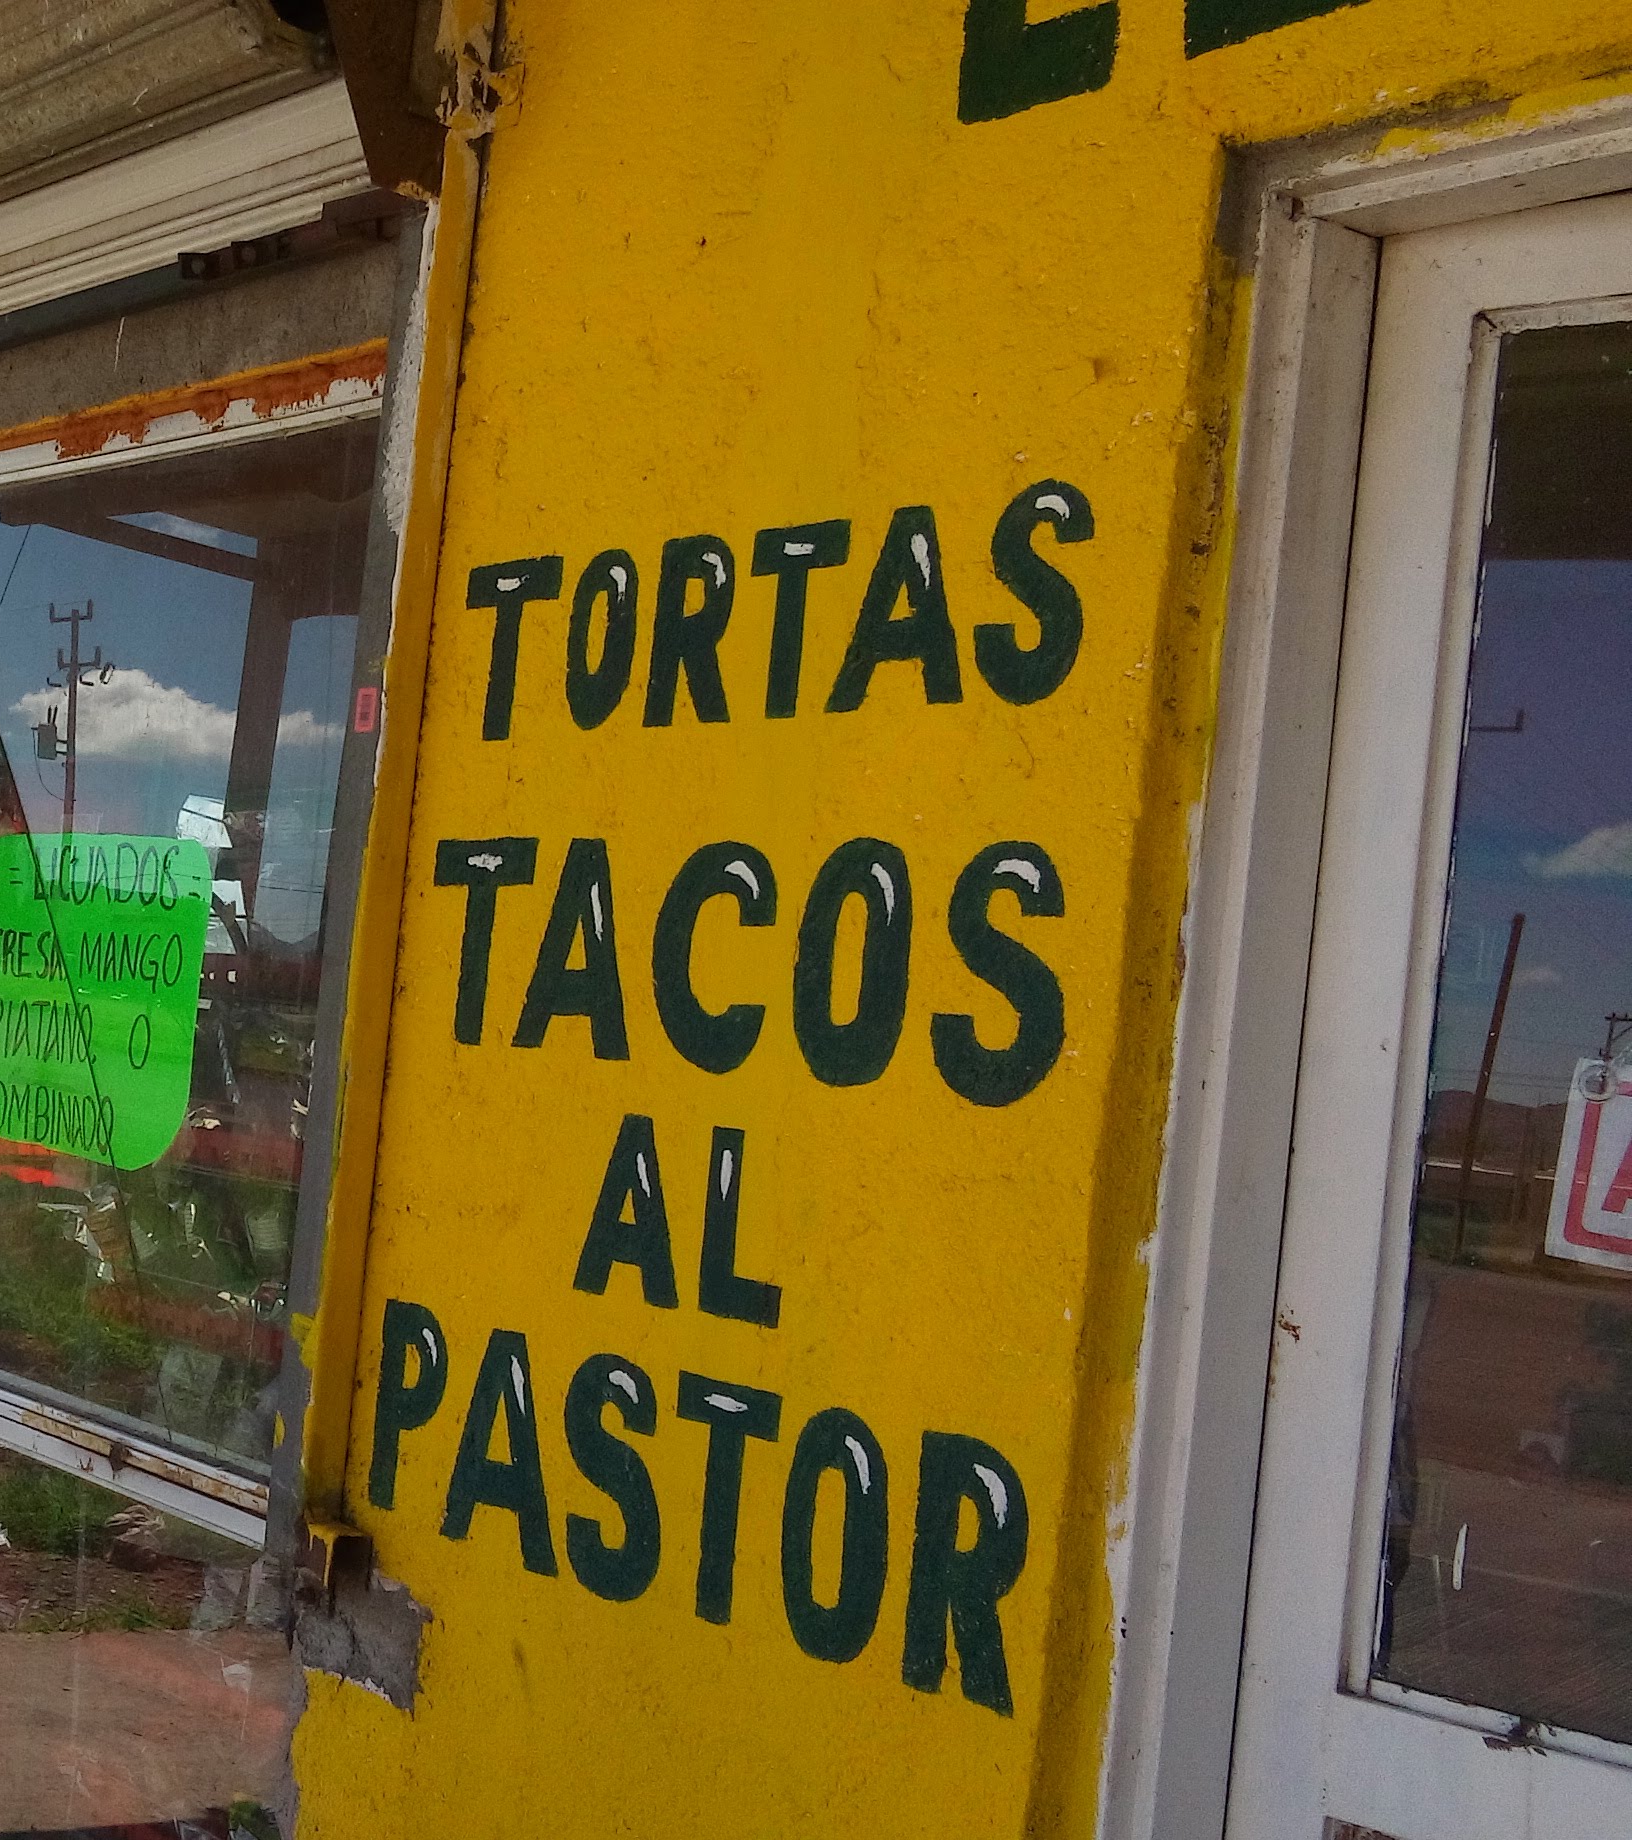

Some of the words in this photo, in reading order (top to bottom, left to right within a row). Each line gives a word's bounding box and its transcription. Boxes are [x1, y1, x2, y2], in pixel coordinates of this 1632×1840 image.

[465, 477, 1095, 742] TORTAS
[33, 842, 180, 910] LICUADOS
[79, 932, 183, 993] MANGO
[433, 835, 1067, 1108] TACOS
[127, 1013, 152, 1070] O
[572, 1113, 783, 1330] AL
[366, 1298, 1030, 1720] PASTOR
